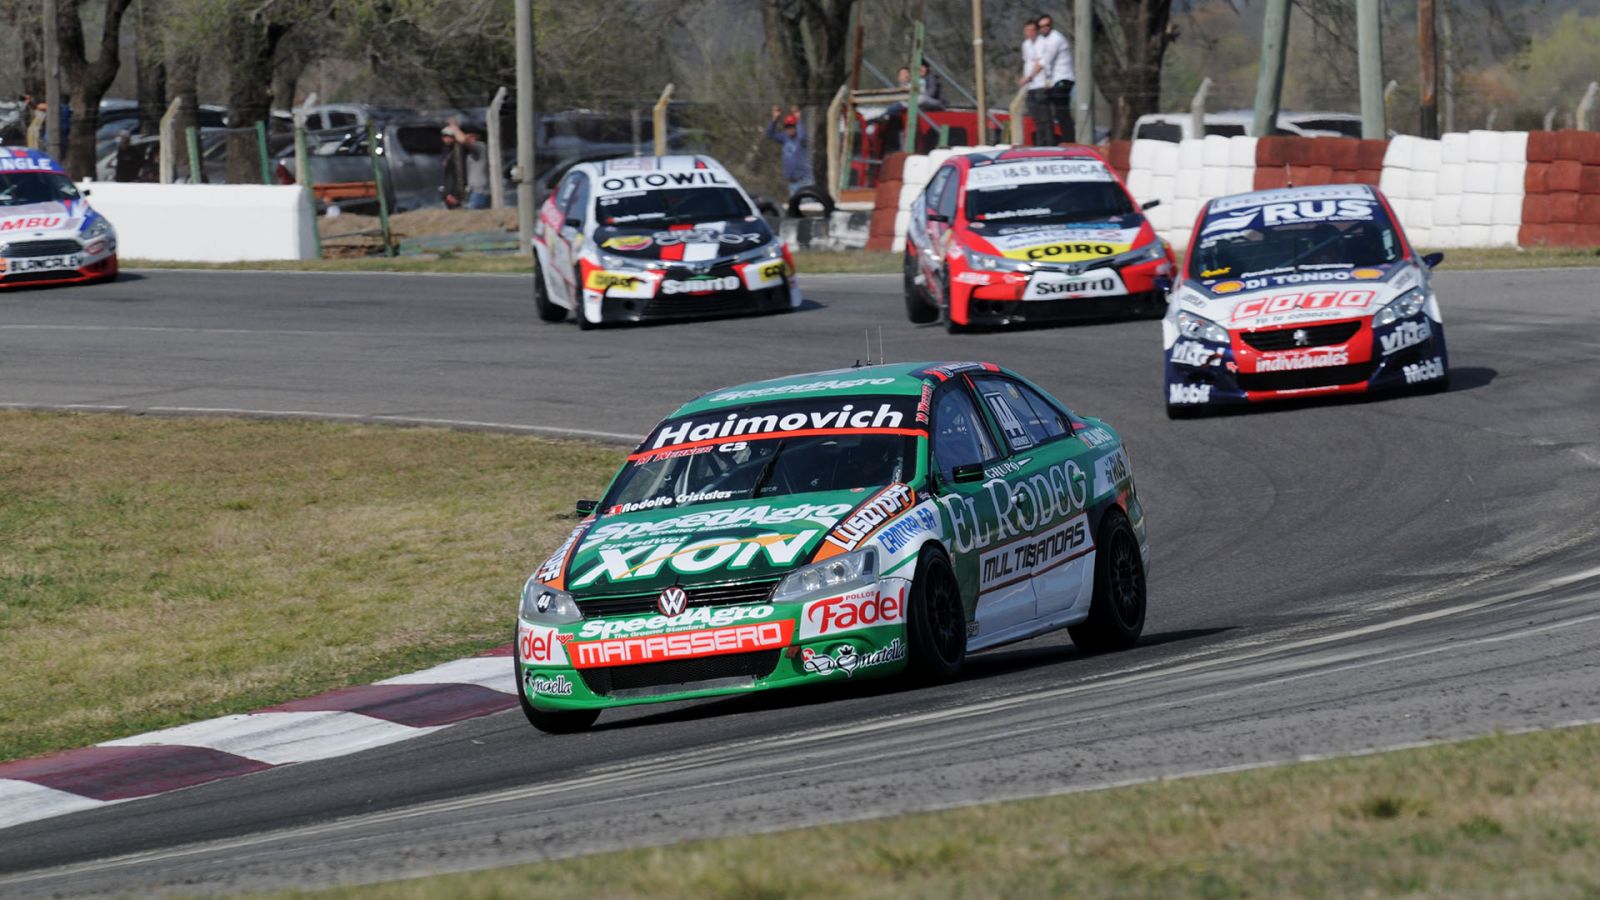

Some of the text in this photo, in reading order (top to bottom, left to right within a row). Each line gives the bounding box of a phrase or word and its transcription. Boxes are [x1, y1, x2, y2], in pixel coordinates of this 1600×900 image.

[603, 172, 728, 191] OTOWIL
[1263, 199, 1374, 222] RUS
[0, 217, 61, 231] MBU
[1026, 244, 1115, 261] COIRO
[1245, 277, 1268, 290] DI
[1273, 270, 1350, 285] TONDO
[1230, 290, 1376, 322] COTO
[1256, 351, 1349, 373] individuales
[652, 403, 904, 450] Haimovich
[718, 442, 748, 453] C3
[983, 460, 1021, 480] GRUPO
[621, 489, 732, 513] Rodolfo Cristales
[594, 503, 853, 542] SpeedAgro
[933, 492, 990, 555] EL
[599, 535, 689, 551] SpeedWet
[983, 521, 1086, 584] MULTIBANDAS
[569, 529, 819, 589] XION
[537, 594, 550, 609] 44
[807, 586, 905, 634] Fadel
[578, 604, 774, 640] SpeedAgro
[631, 629, 665, 637] Greener
[666, 624, 706, 633] Standard
[520, 629, 554, 662] del
[578, 622, 782, 664] MANASSERO
